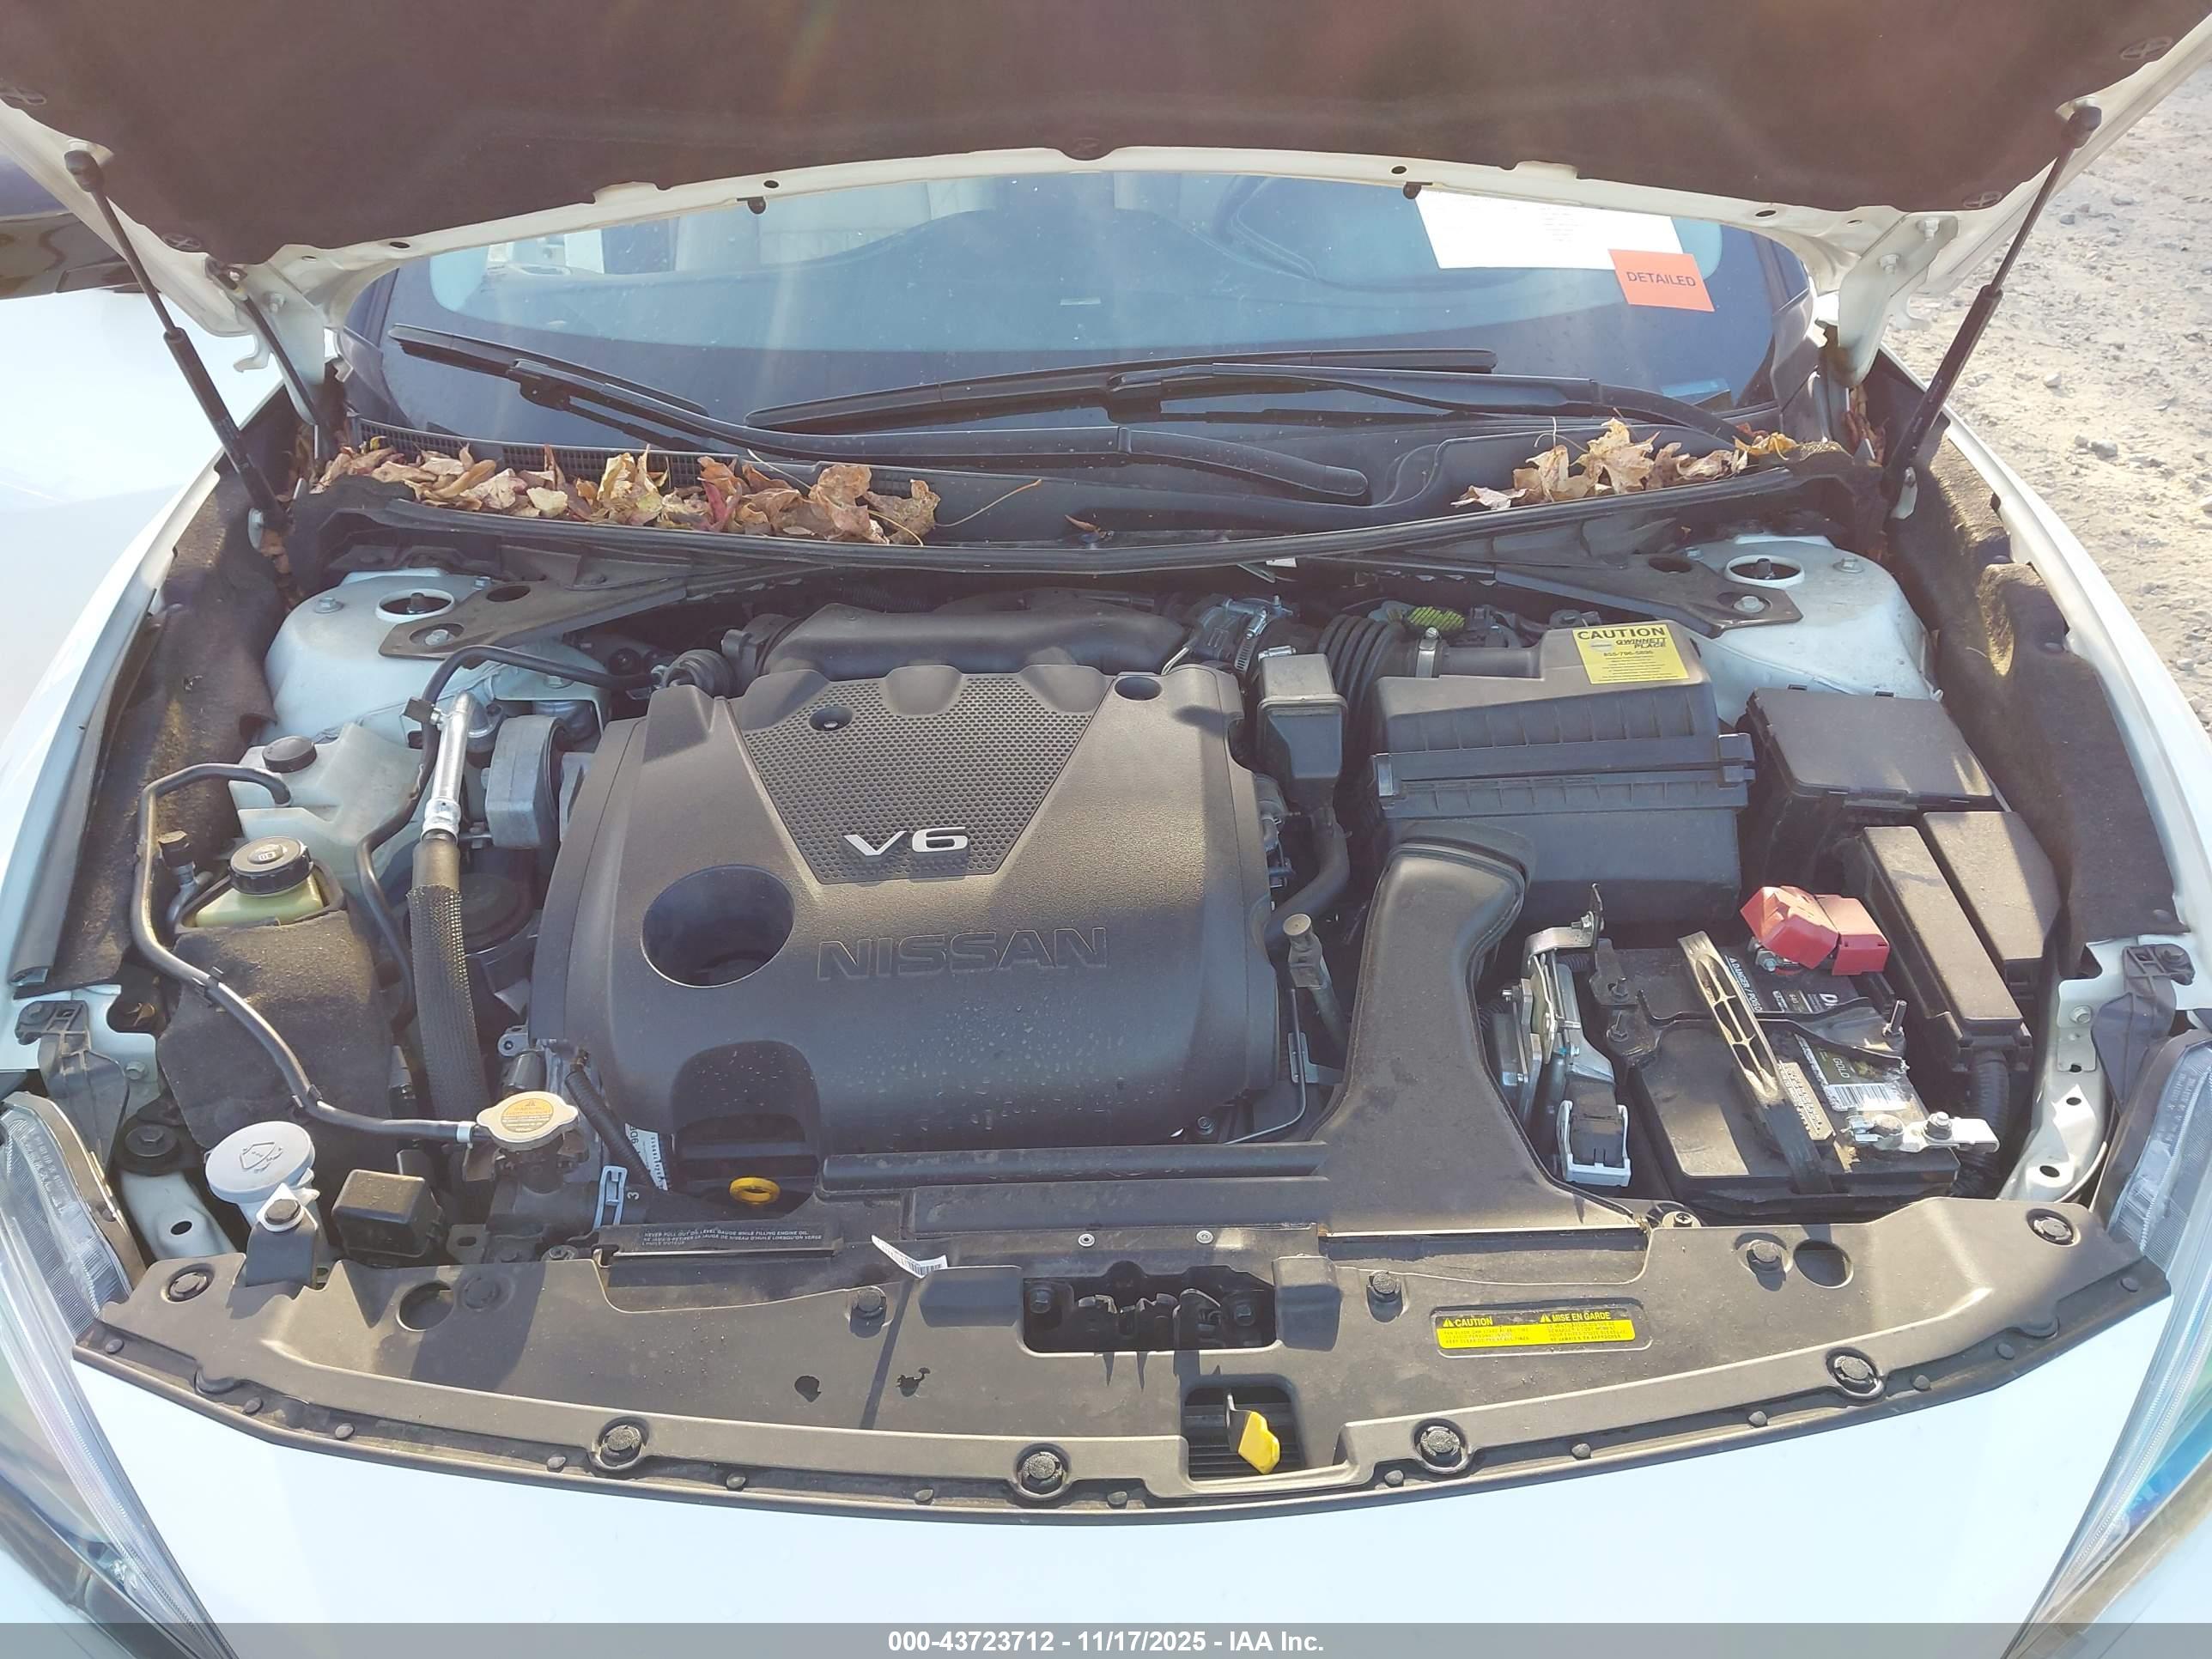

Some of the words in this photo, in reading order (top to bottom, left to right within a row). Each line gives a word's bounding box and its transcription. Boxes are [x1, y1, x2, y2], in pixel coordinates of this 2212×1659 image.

[1626, 271, 1697, 287] DETAILED
[1577, 627, 1666, 640] CAUTION
[843, 826, 969, 857] V6
[817, 927, 1108, 981] NISSAN
[1732, 961, 1750, 988] DANGER
[1832, 1057, 1850, 1079] GOLD
[1455, 1316, 1493, 1327] CAUTION
[1552, 1314, 1571, 1322] MISE
[1571, 1313, 1583, 1322] EN
[1583, 1312, 1611, 1321] GARDE
